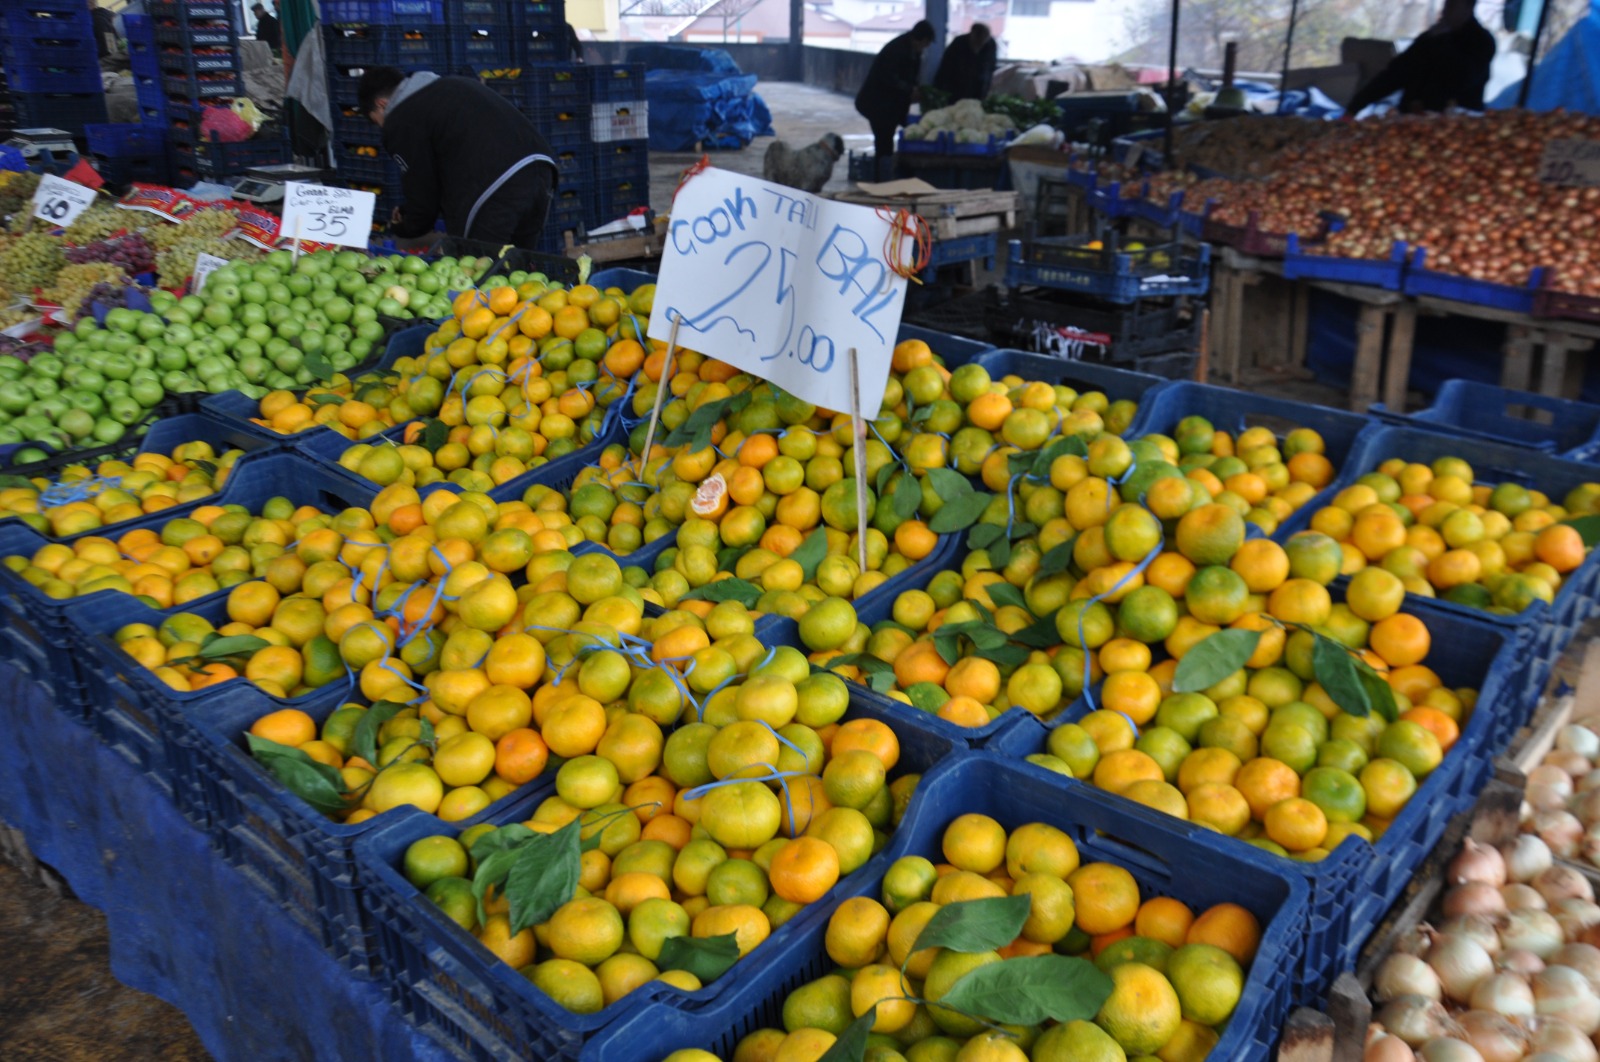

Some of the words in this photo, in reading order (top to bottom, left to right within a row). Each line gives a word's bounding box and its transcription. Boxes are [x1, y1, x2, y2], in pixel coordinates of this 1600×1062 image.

[40, 197, 71, 220] 60
[306, 212, 350, 237] 35
[816, 223, 898, 345] BAL
